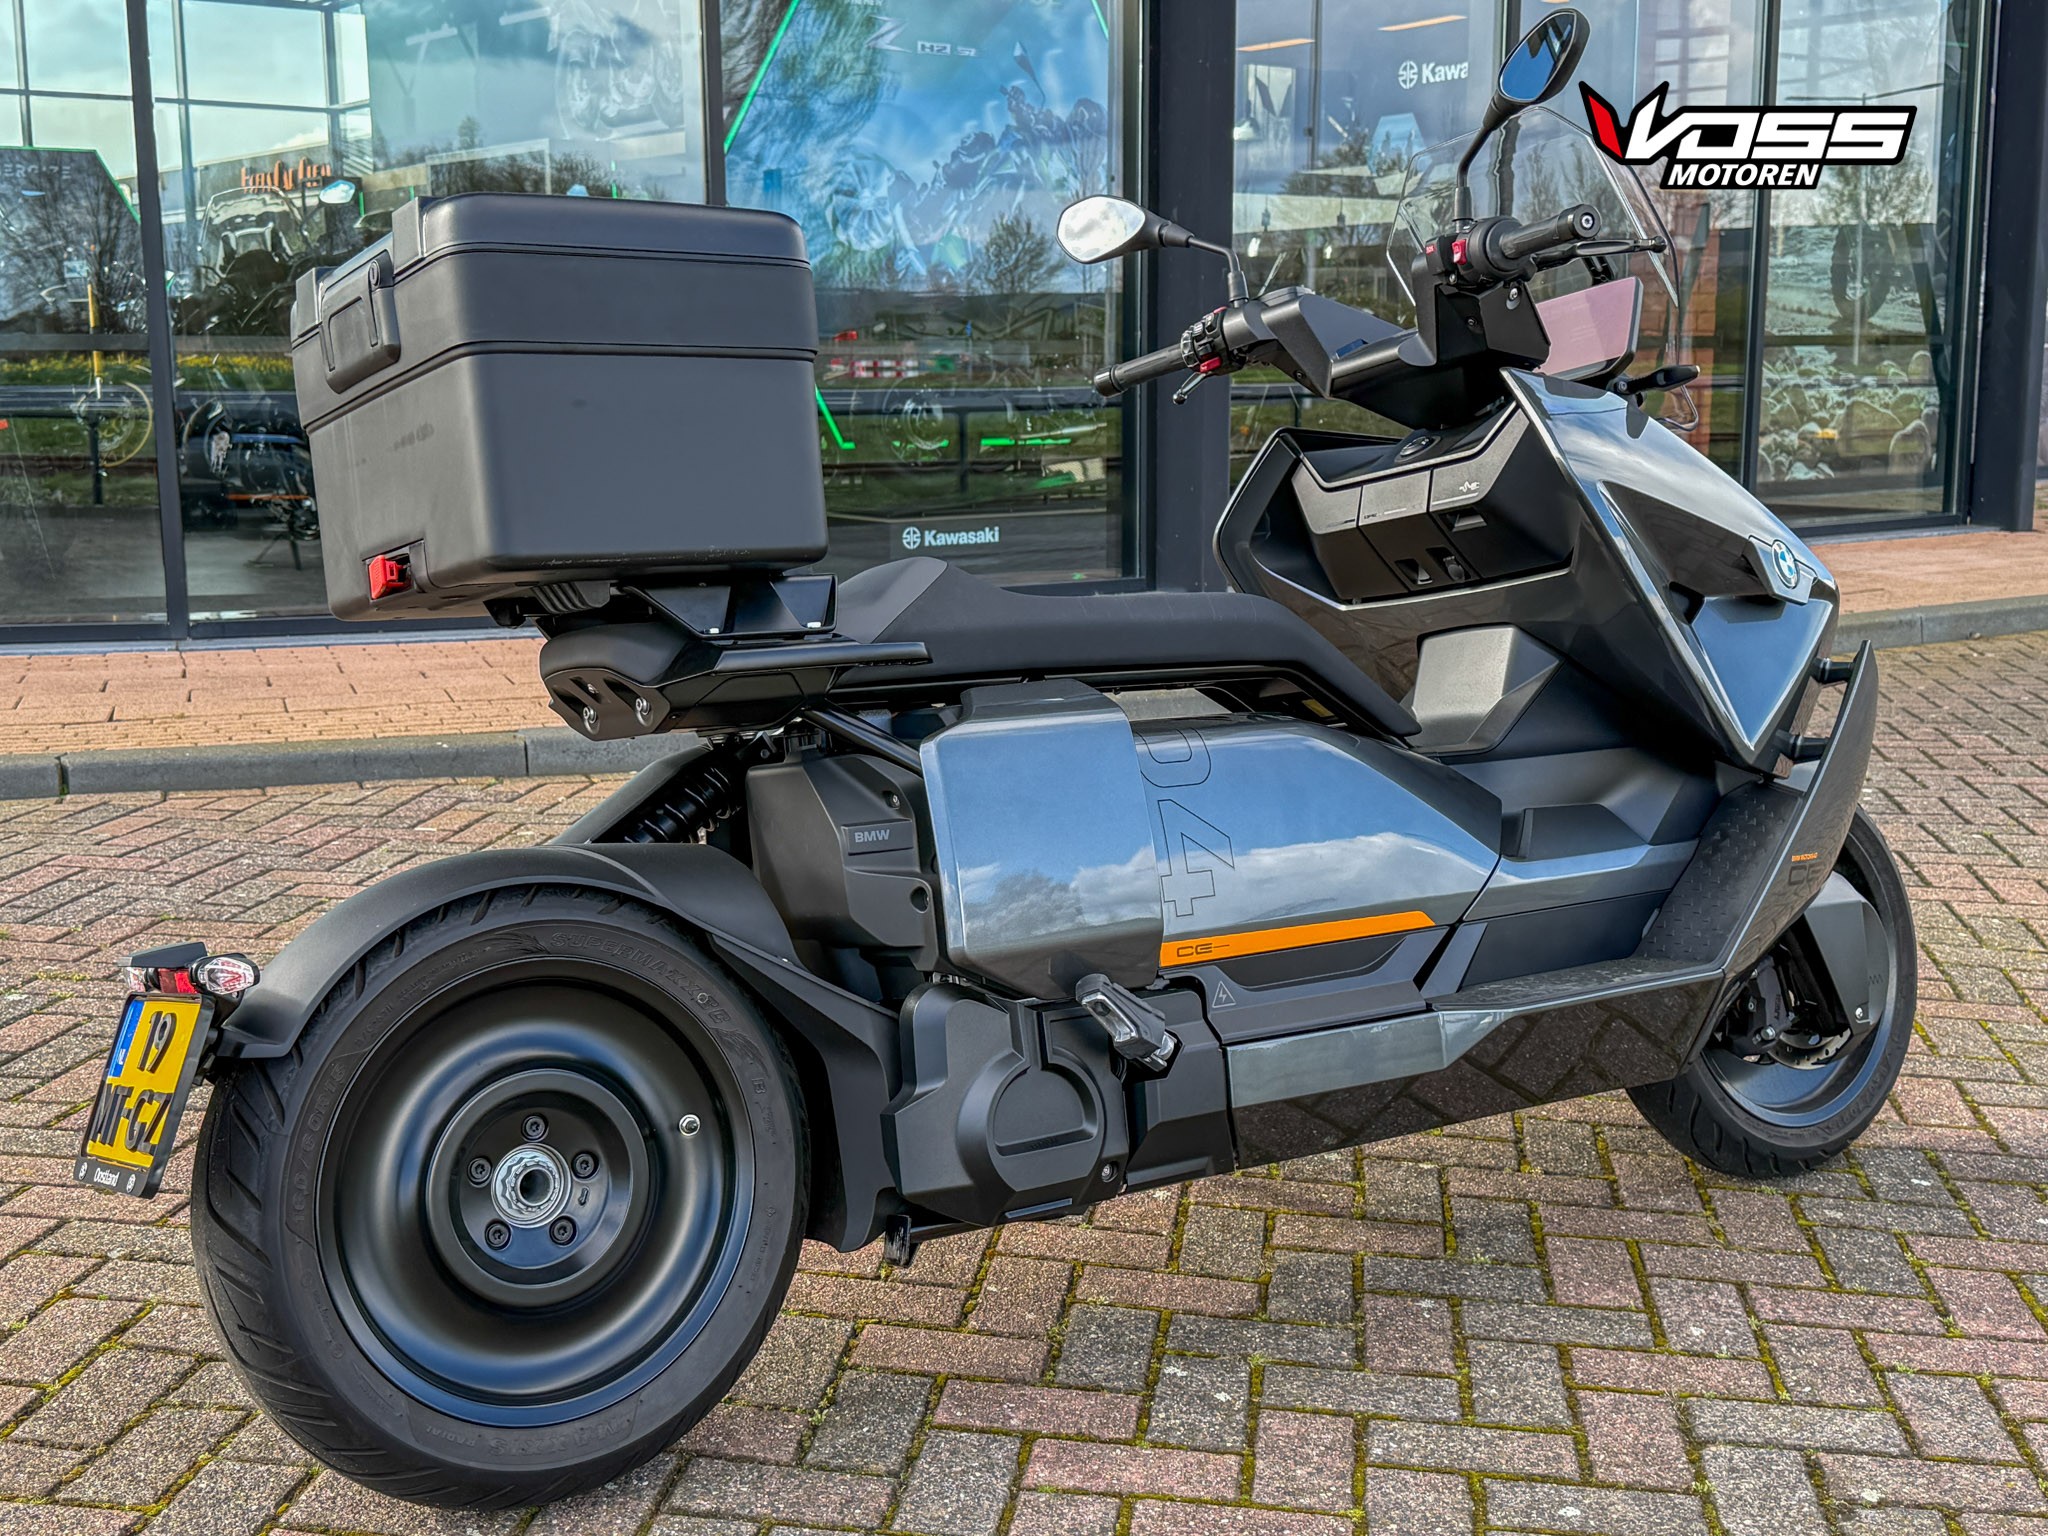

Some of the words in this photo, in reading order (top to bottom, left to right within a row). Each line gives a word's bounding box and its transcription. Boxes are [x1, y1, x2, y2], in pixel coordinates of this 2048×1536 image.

[924, 526, 1000, 547] Kawasaki
[854, 829, 890, 843] BMW
[138, 1011, 176, 1073] 19
